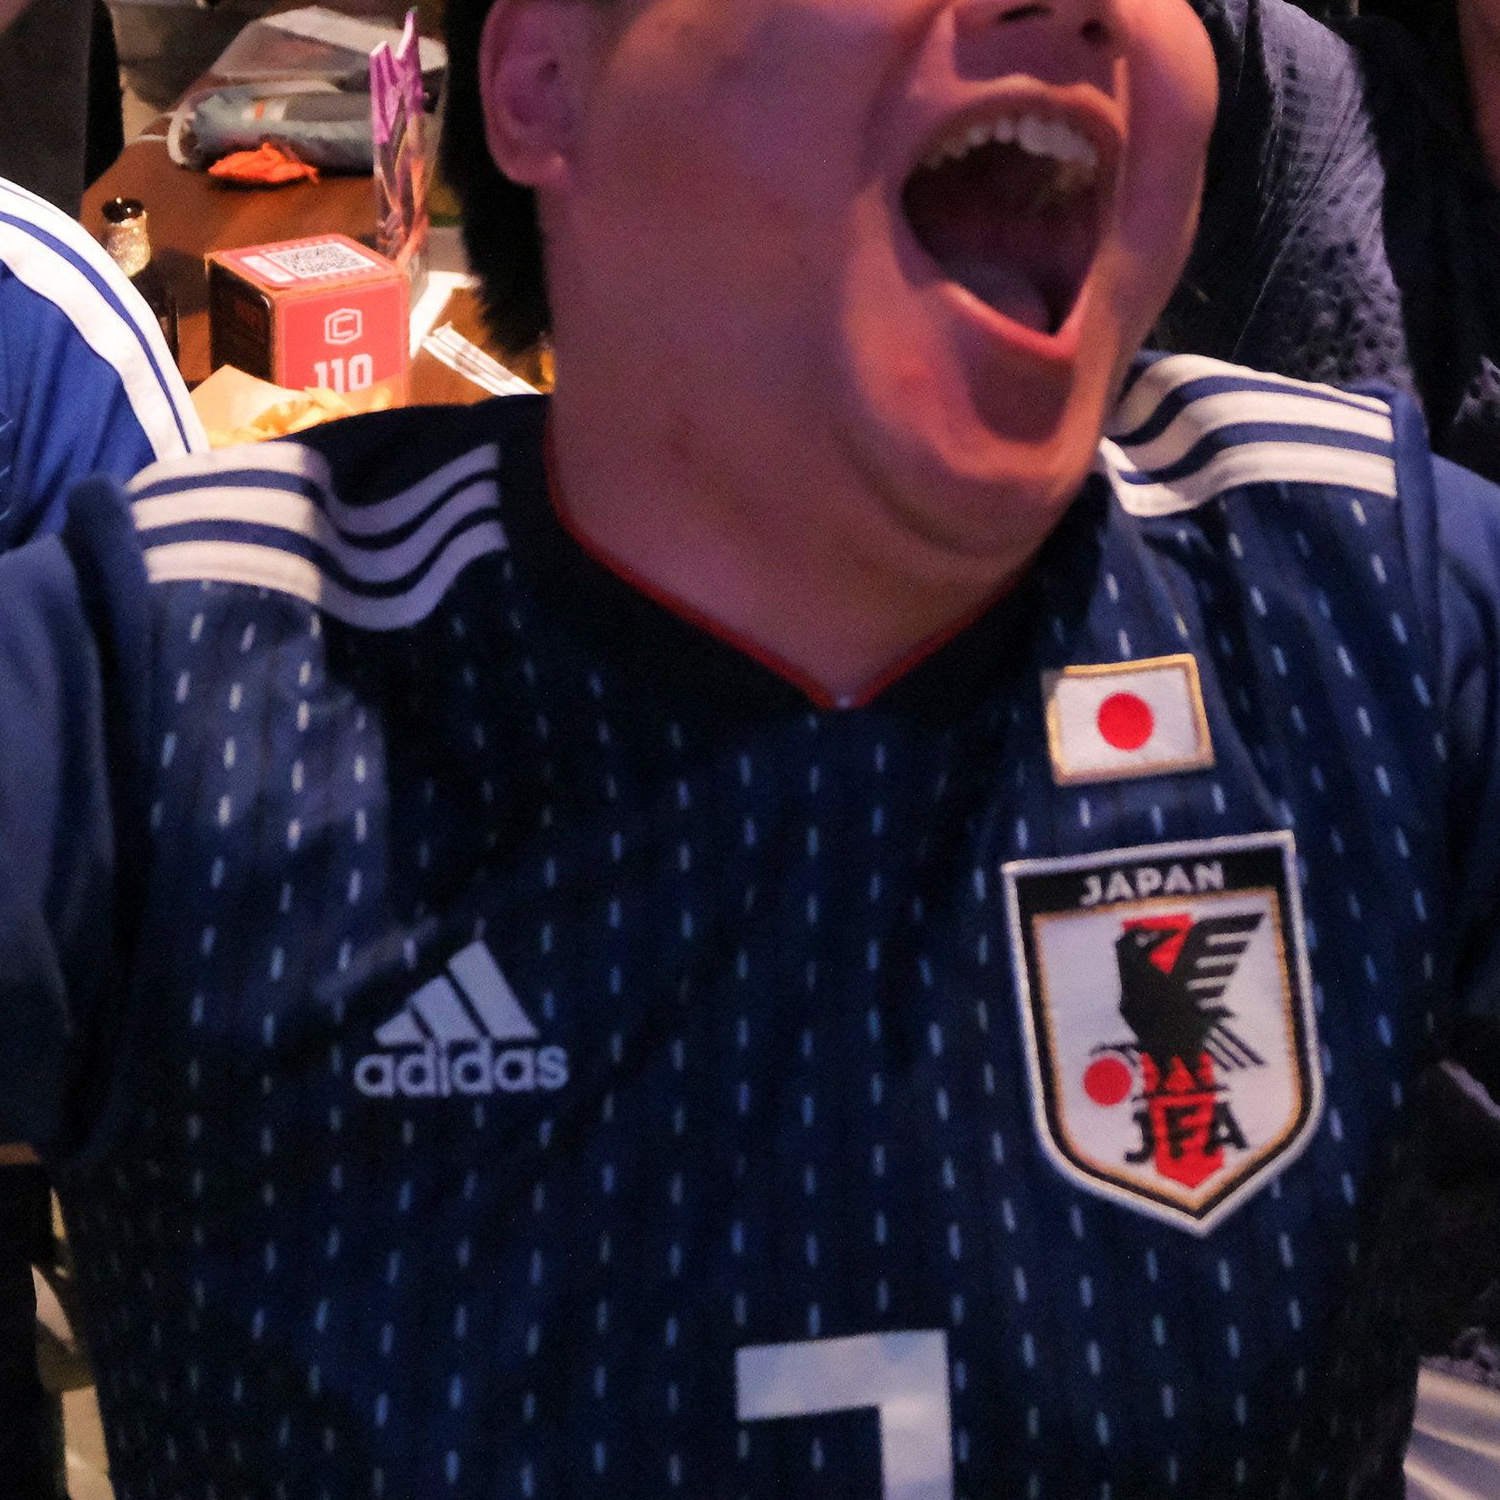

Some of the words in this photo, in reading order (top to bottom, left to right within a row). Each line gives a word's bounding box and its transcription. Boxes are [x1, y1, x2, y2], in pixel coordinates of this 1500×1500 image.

[314, 353, 373, 396] 110
[1079, 861, 1225, 906] JAPAN
[354, 1039, 569, 1098] adidas
[1124, 1102, 1248, 1164] JFA
